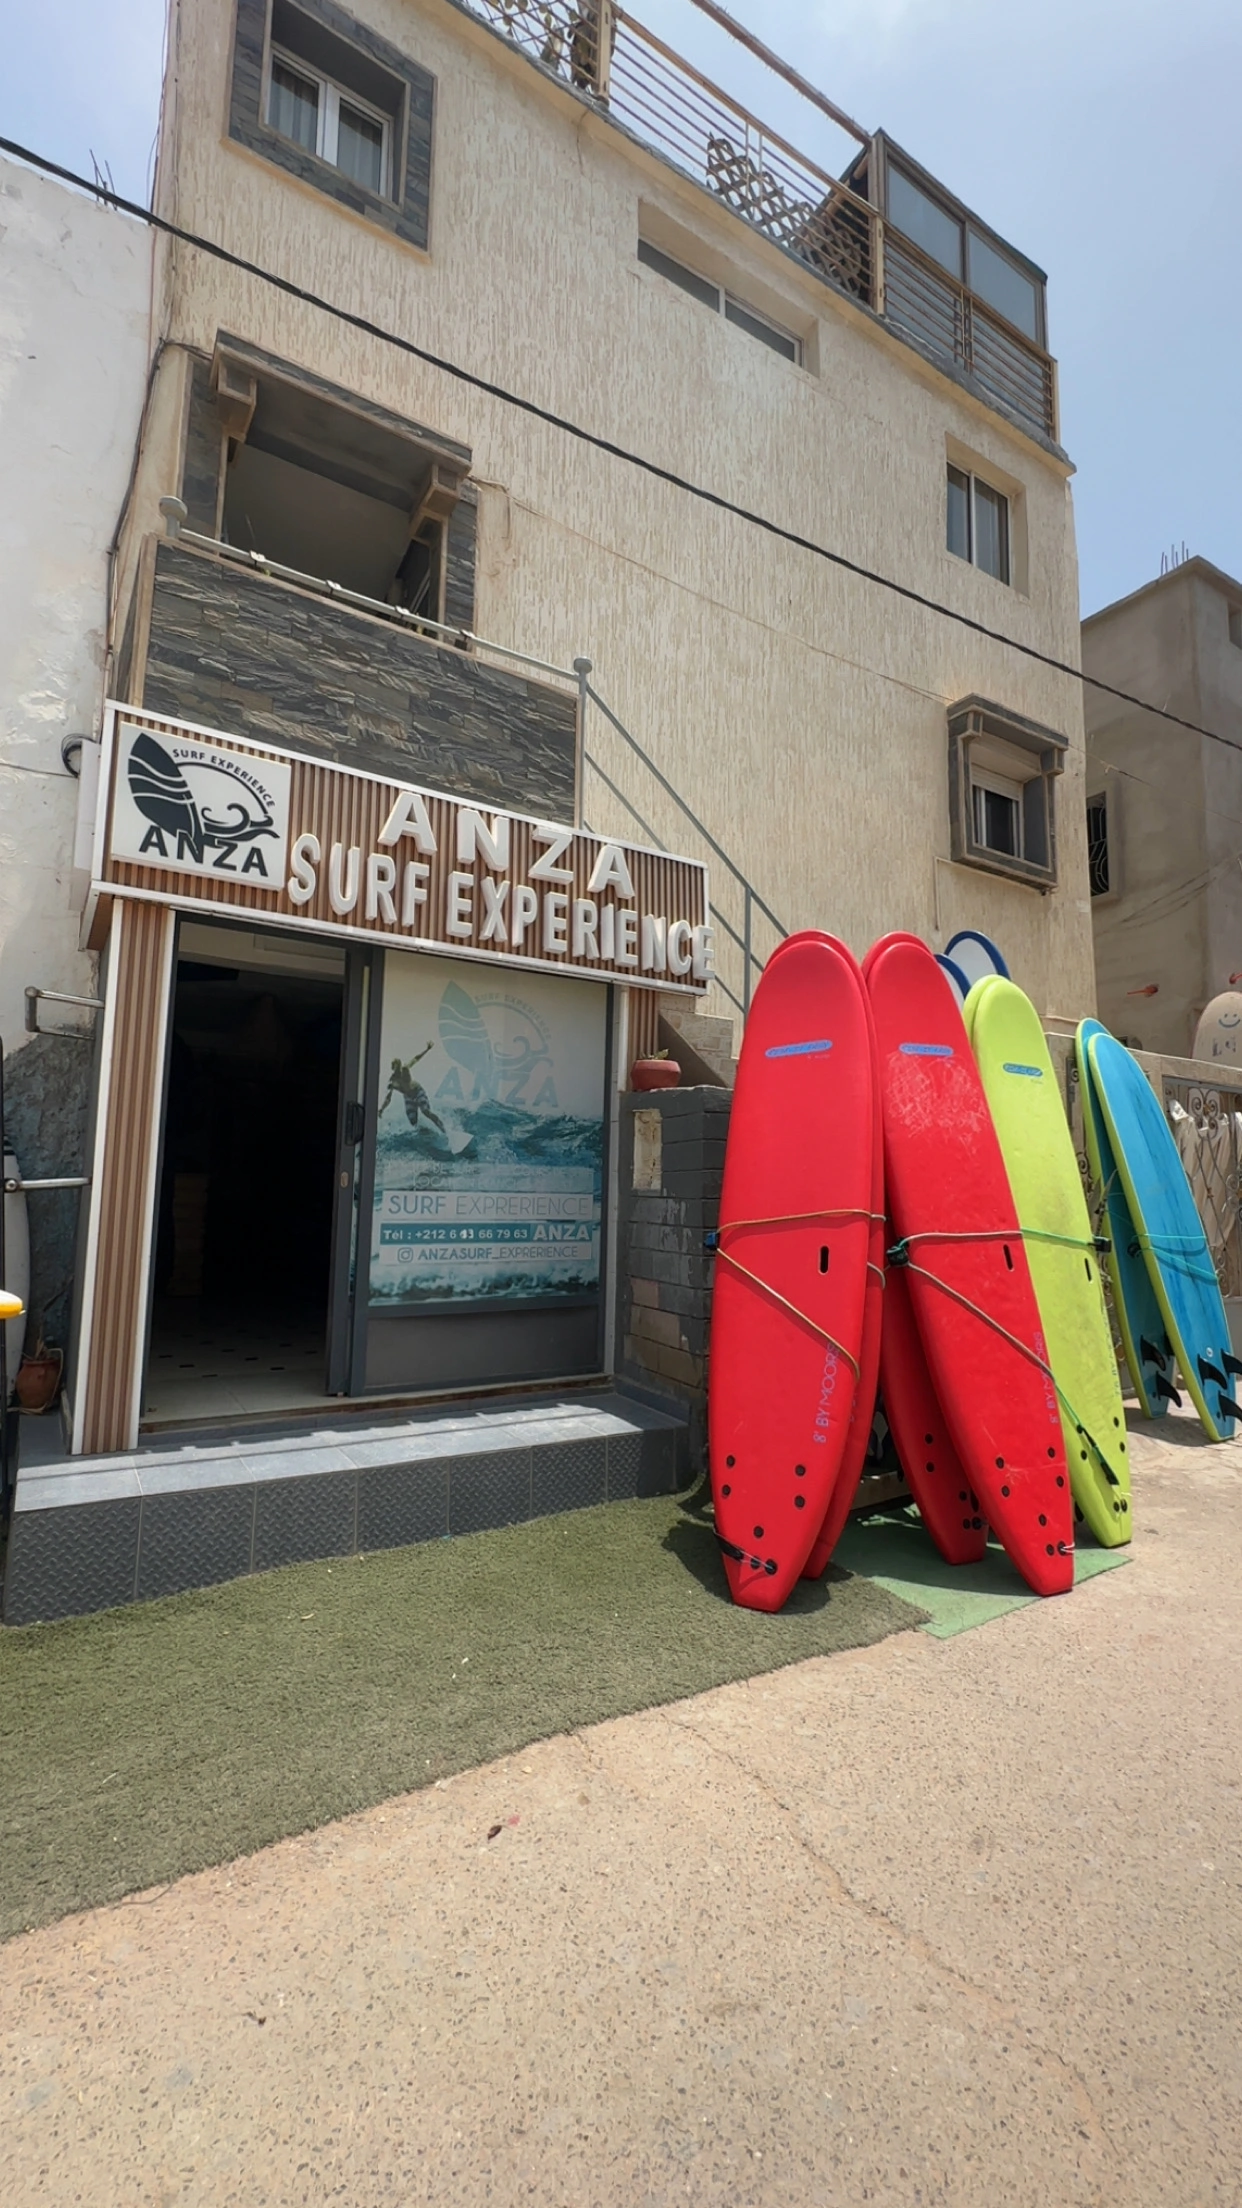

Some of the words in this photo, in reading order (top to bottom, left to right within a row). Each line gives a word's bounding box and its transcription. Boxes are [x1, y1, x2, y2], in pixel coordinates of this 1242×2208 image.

[172, 748, 206, 760] SURF
[210, 755, 276, 807] EXPERIENCE
[138, 825, 269, 878] ANZA
[377, 791, 636, 900] ANZA
[287, 833, 430, 927] SURF
[446, 870, 716, 981] EXPERIENCE
[474, 992, 500, 1003] SURF
[504, 994, 552, 1040] EXPERIENCE
[434, 1066, 559, 1108] ANZA
[388, 1195, 447, 1215] SURF
[455, 1195, 589, 1216] EXPRERIENCE
[415, 1229, 446, 1240] +212
[449, 1229, 457, 1239] 6
[478, 1229, 493, 1239] 66
[496, 1229, 511, 1239] 79
[514, 1229, 528, 1239] 63
[533, 1224, 590, 1241] ANZA
[815, 1407, 831, 1427] BY
[1045, 1391, 1056, 1410] BY
